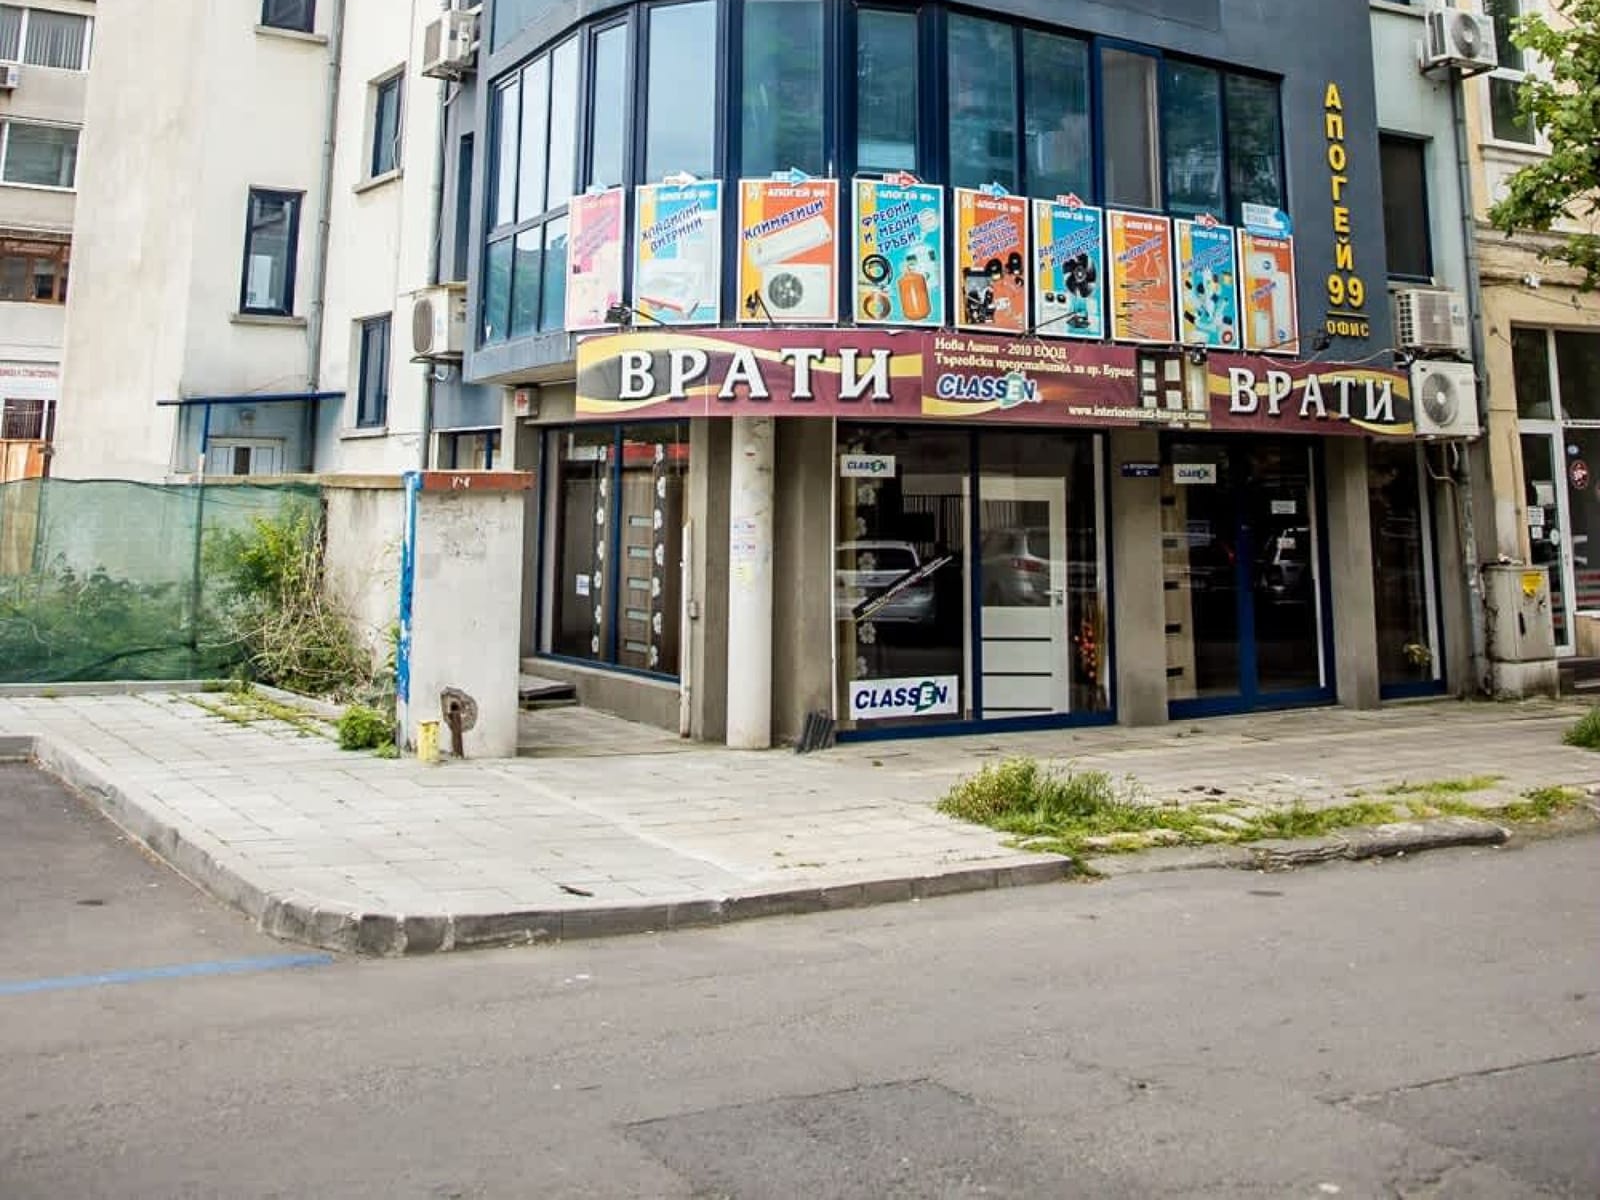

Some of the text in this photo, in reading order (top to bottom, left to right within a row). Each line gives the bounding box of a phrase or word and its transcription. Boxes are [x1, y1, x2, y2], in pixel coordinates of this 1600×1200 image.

[1325, 81, 1354, 271] АПОГЕЙ
[743, 199, 824, 240] КЛИМАТИЦИ
[862, 200, 911, 226] ФРЕОНИ
[879, 213, 919, 236] МЕДНИ
[878, 231, 916, 253] ТРЪБИ
[1327, 274, 1365, 308] 99
[935, 337, 965, 351] Нова
[1326, 319, 1369, 337] ОФИС
[618, 348, 891, 400] ВРАТИ
[937, 371, 1038, 407] CLASSEN
[1228, 367, 1396, 422] ВРАТИ
[847, 459, 888, 473] CLASSEN
[854, 680, 948, 712] CLASSEN
